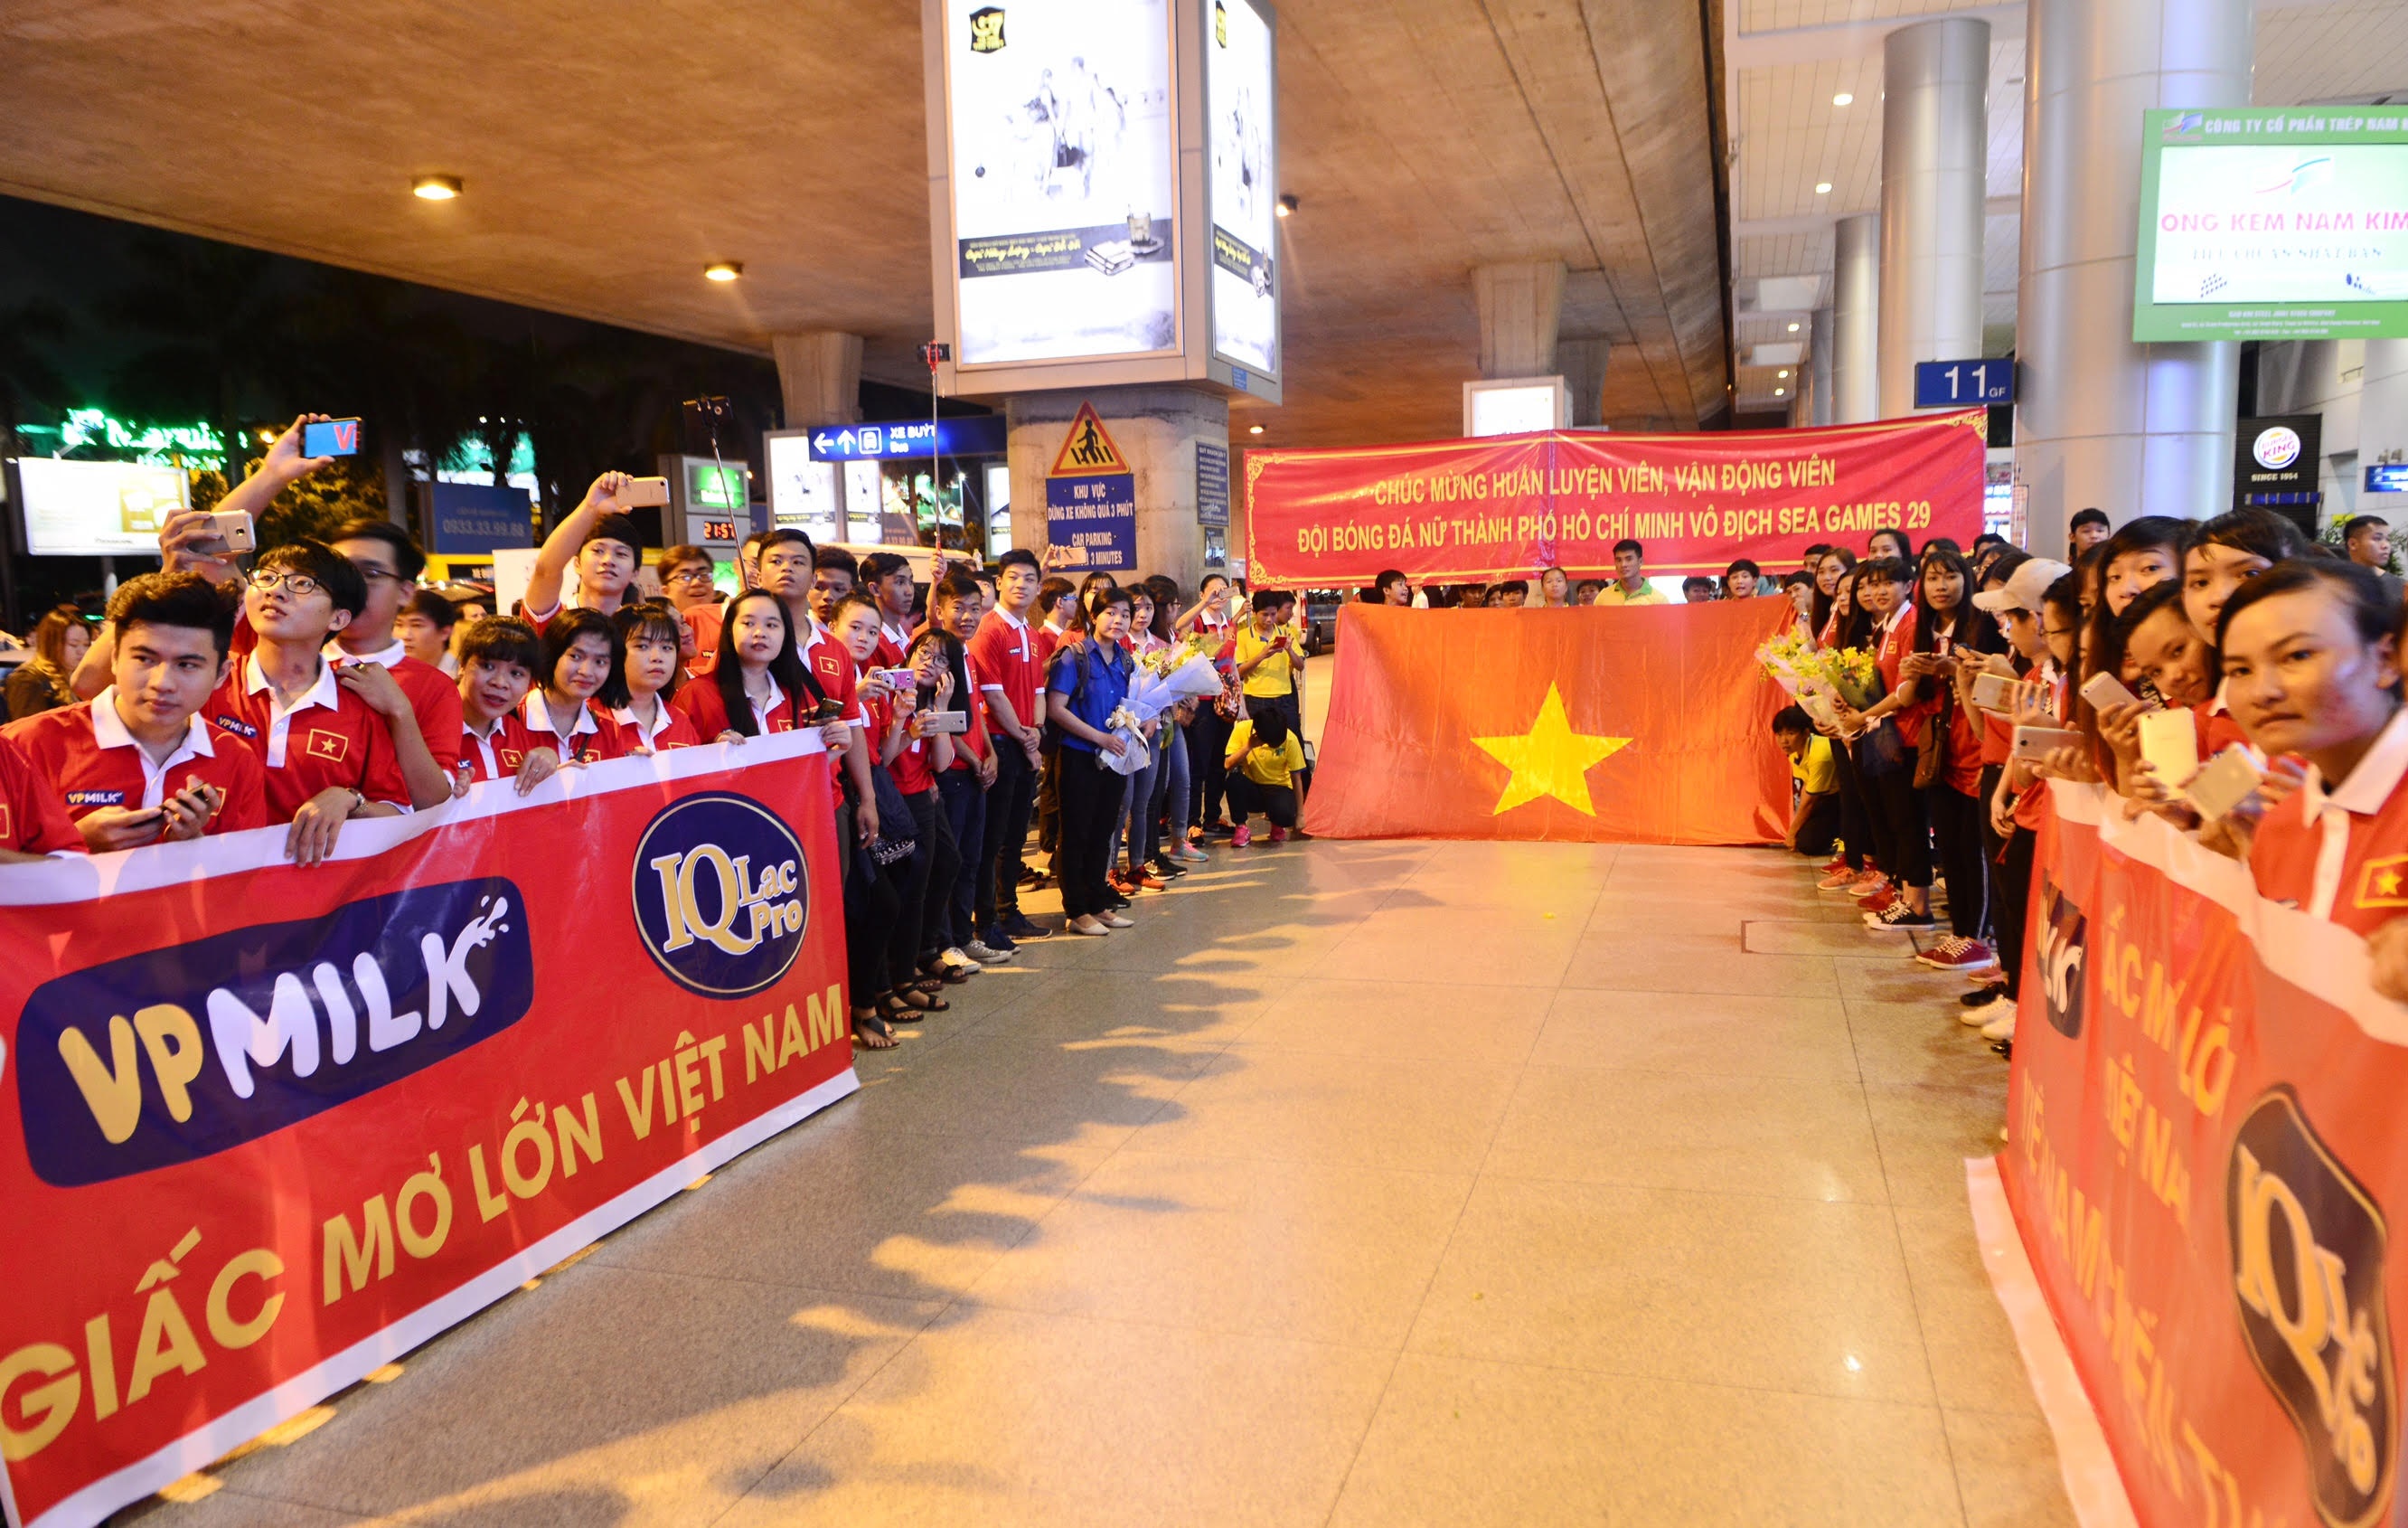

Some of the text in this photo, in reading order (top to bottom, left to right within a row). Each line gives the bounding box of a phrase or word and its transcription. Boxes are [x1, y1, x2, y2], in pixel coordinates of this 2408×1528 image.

[2246, 118, 2262, 132] TY
[2296, 212, 2354, 231] NAM
[1945, 364, 2006, 399] 11 GF
[890, 426, 906, 439] XE
[890, 441, 909, 454] Bus
[2263, 440, 2295, 458] KING
[1375, 452, 1835, 505] CHÚC MỪNG HUẤN LUYỆN VIÊN, VẬN ĐỘNG VIÊN
[1074, 481, 1106, 502] KHU VỰC
[1066, 505, 1074, 520] XE
[1075, 503, 1096, 519] KHÔNG
[1097, 500, 1110, 519] QUÁ
[1111, 504, 1115, 518] 3
[1116, 499, 1133, 517] PHÚT
[703, 522, 737, 541] 21:57
[1072, 531, 1113, 547] CAR PARKING
[1297, 500, 1931, 559] ĐỘI BÓNG ĐÁ NỮ THÀNH PHỐ HỒ CHÍ MINH VÔ ĐỊCH SEA GAMES 29
[1090, 552, 1096, 566] 3
[1096, 550, 1123, 566] MINUTES
[67, 792, 123, 804] VPMILK
[650, 843, 797, 956] IQ Lac
[748, 899, 804, 943] Pro
[58, 895, 509, 1145] VPMILK
[0, 983, 844, 1463] GIẤC MƠ LỚN VIỆT NAM
